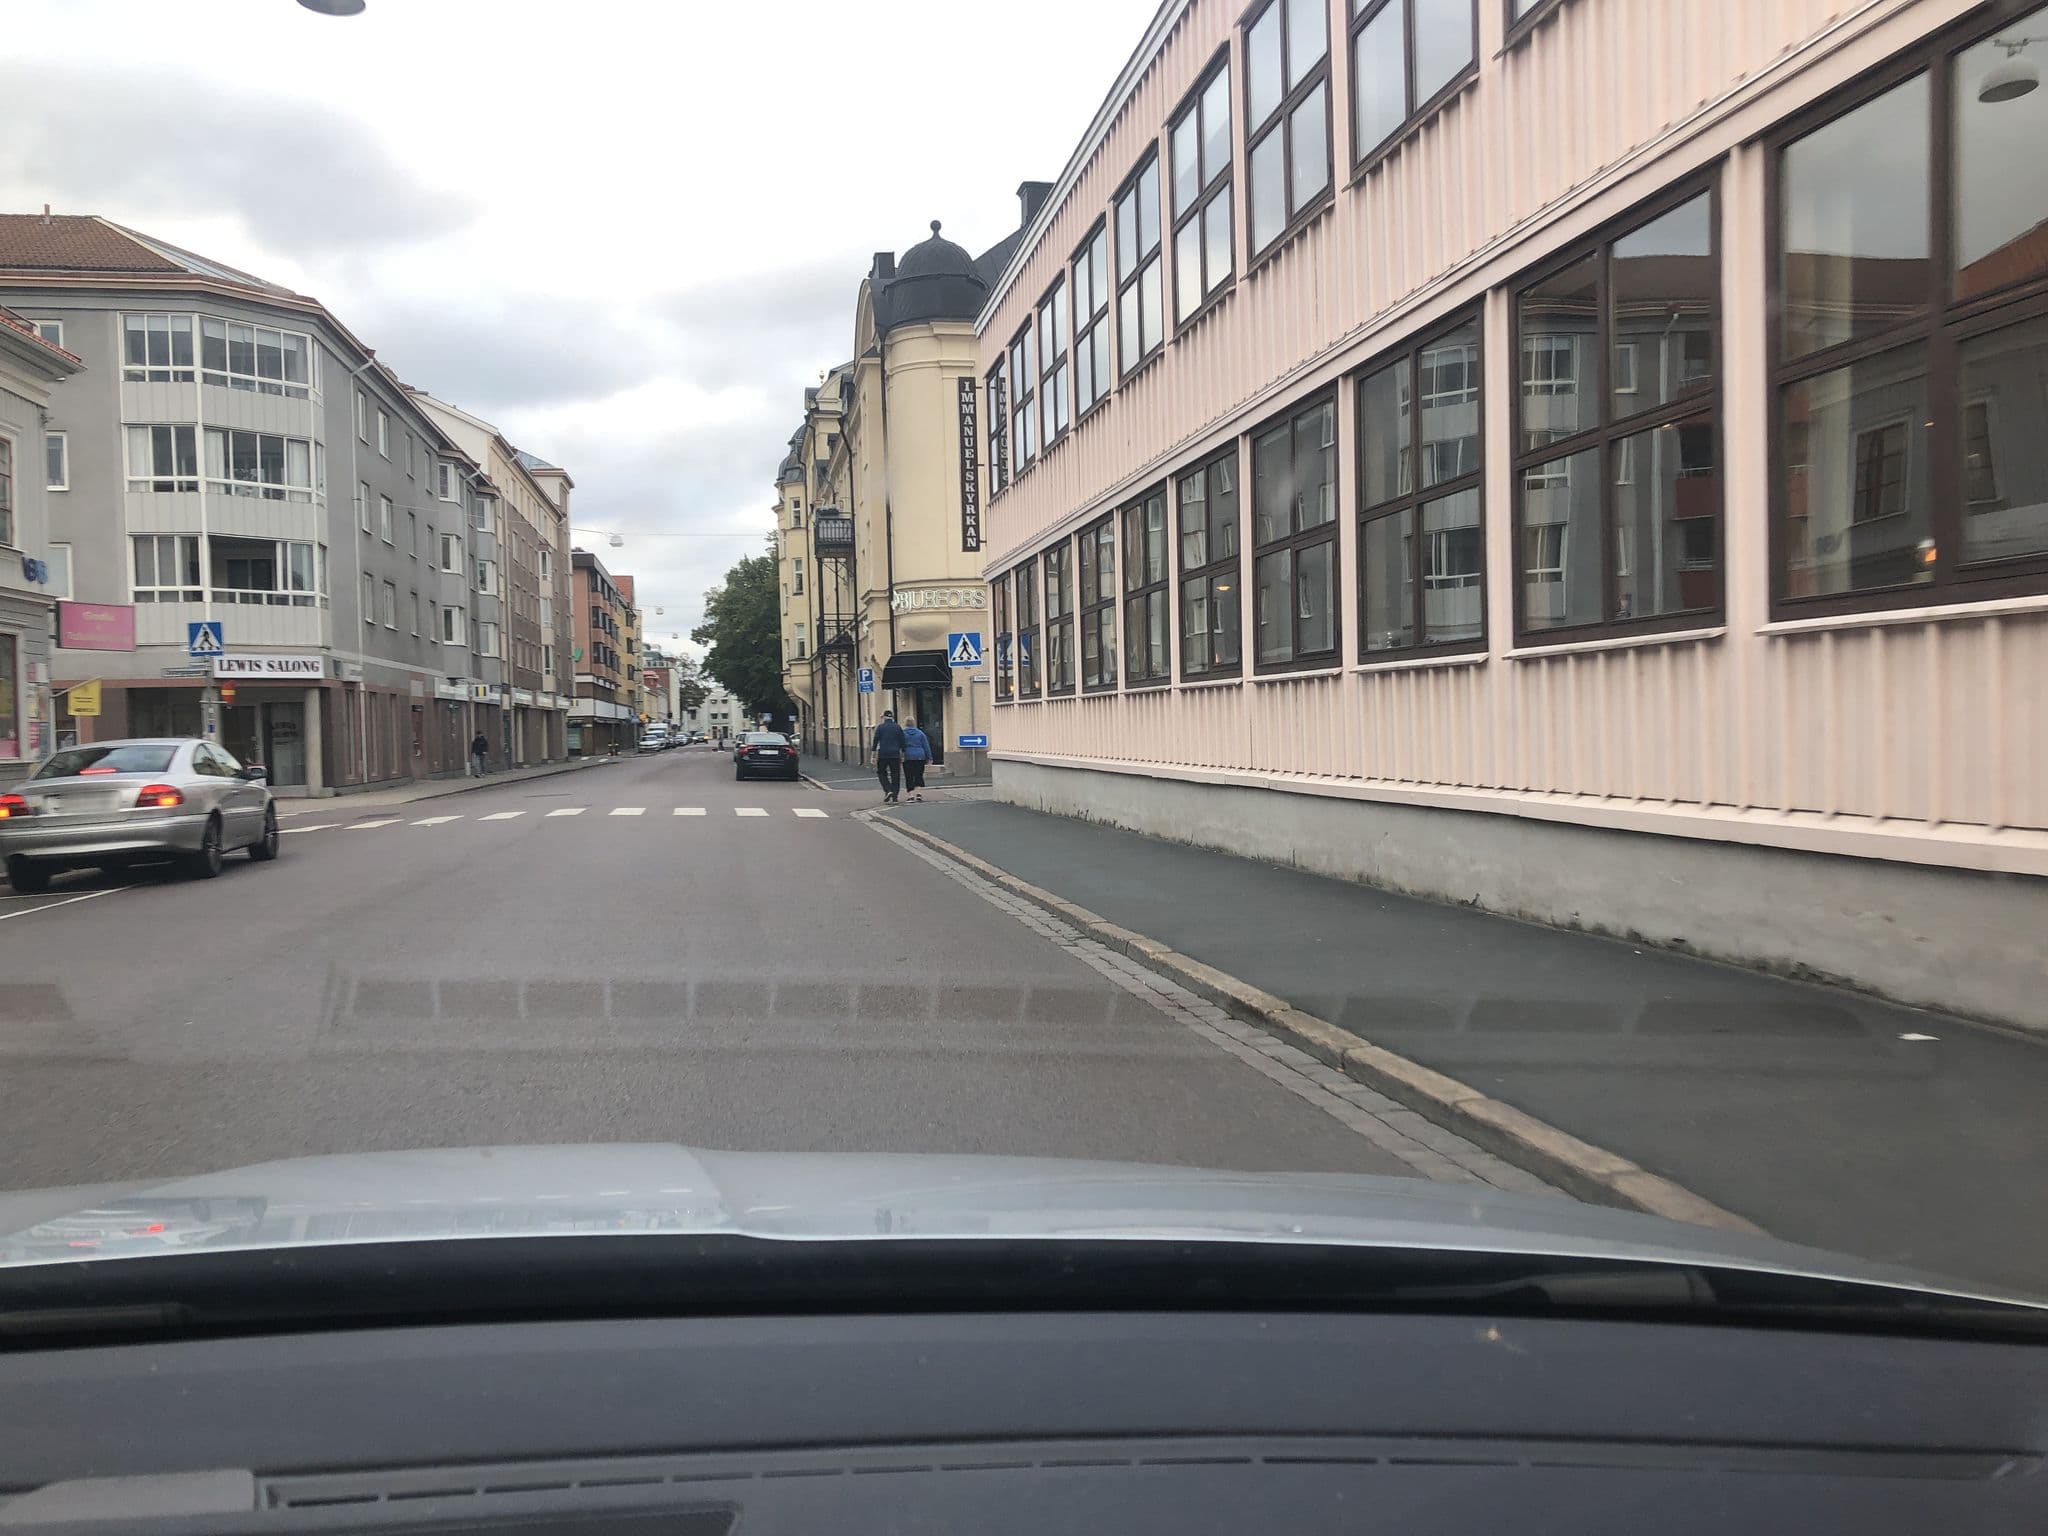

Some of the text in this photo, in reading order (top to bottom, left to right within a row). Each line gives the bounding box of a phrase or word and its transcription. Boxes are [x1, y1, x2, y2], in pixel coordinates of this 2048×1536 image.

[960, 381, 977, 547] IMMANUELSKYRKAN
[219, 659, 262, 672] LEWIS
[266, 660, 320, 673] SALONG
[861, 670, 870, 681] P
